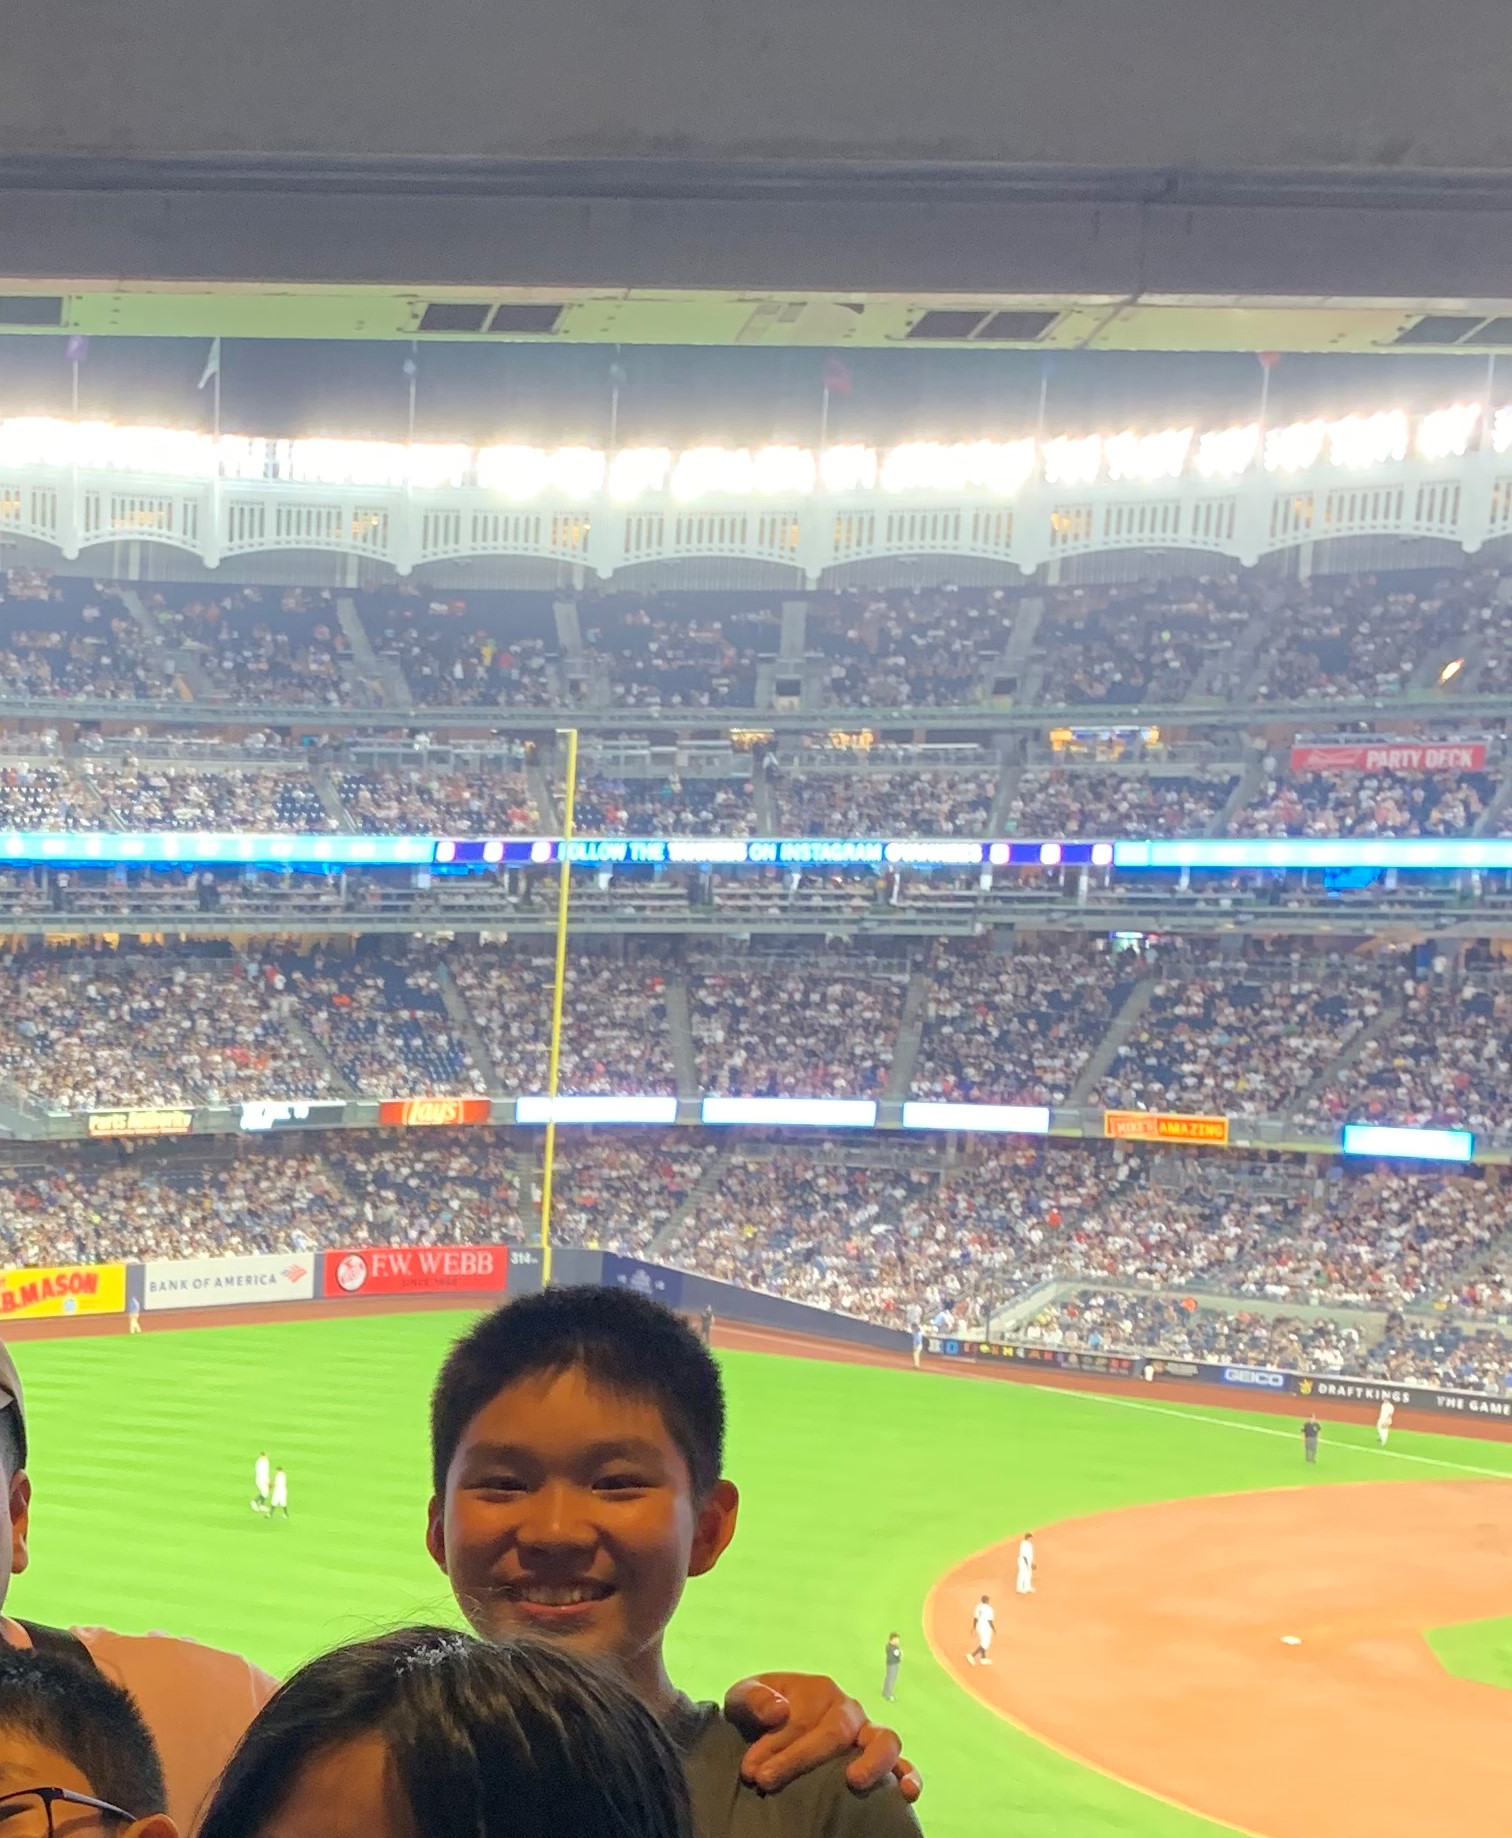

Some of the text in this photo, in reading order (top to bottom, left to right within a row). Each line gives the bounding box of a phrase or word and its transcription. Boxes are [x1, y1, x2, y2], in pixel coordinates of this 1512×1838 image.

[1366, 748, 1473, 769] PARTY DECK
[629, 842, 665, 861] THE
[749, 843, 777, 862] ON
[780, 843, 883, 862] INSTAGRAM
[419, 1250, 494, 1276] WEBB
[149, 1273, 277, 1293] BANK OF AMERICA
[1224, 1368, 1284, 1387] GEICO
[1318, 1383, 1511, 1417] DRAFTKINGS THE GAME
